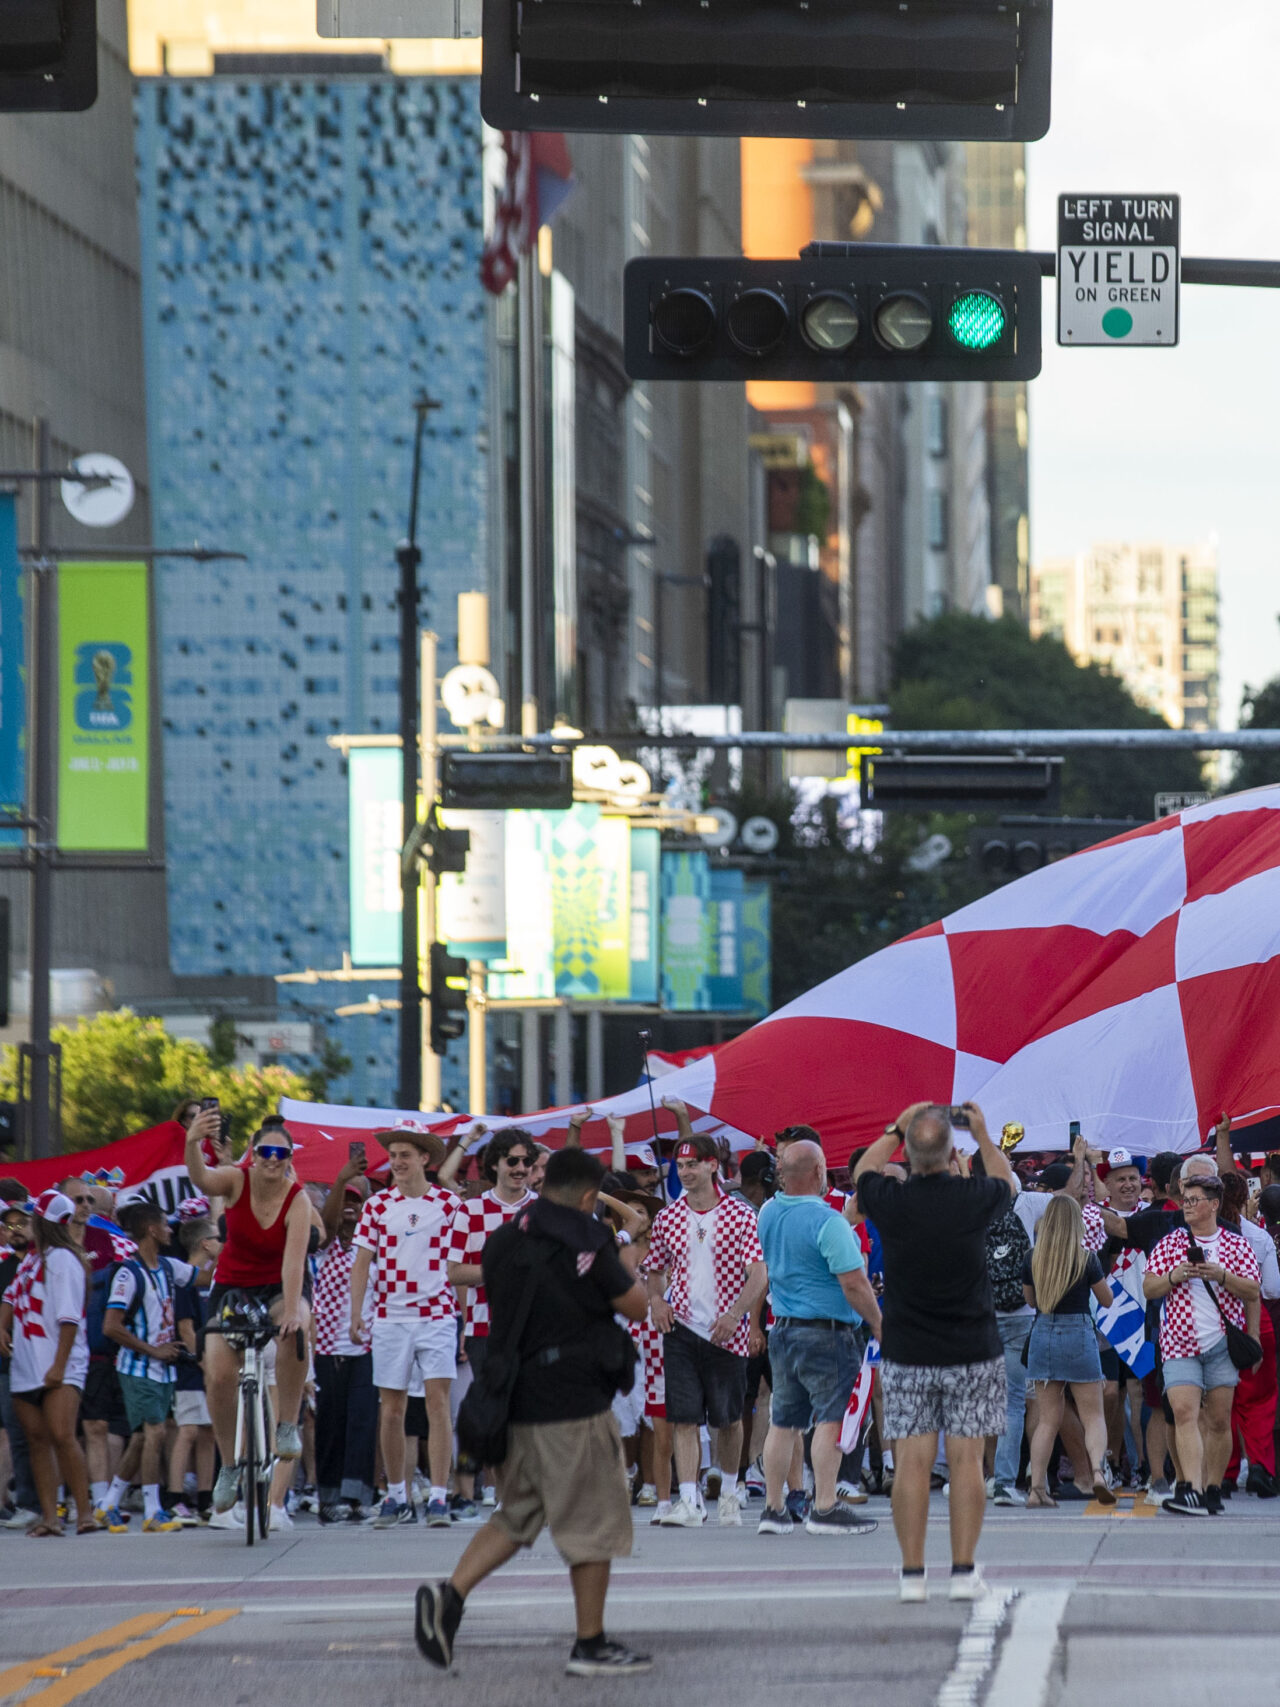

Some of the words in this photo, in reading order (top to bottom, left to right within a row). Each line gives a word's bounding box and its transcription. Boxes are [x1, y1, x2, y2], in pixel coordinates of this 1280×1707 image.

[1064, 200, 1112, 219] LEFT
[1121, 200, 1173, 219] TURN
[1083, 222, 1155, 241] SIGNAL
[1067, 251, 1170, 284] YIELD
[1075, 287, 1097, 302] ON
[1108, 287, 1161, 302] GREEN
